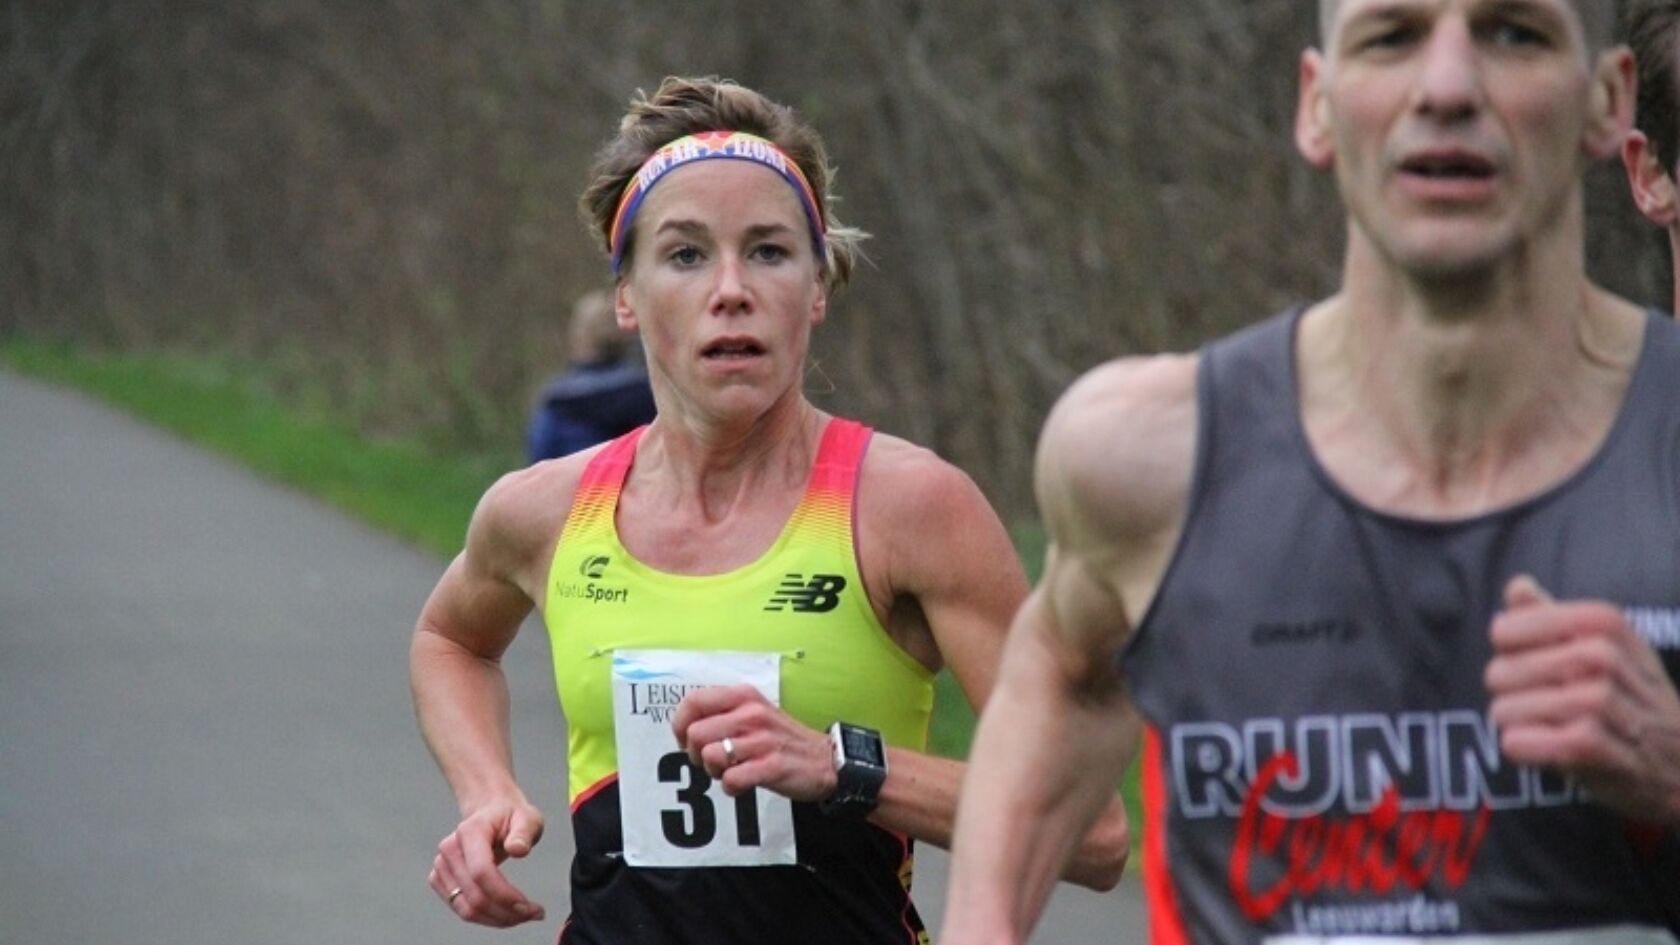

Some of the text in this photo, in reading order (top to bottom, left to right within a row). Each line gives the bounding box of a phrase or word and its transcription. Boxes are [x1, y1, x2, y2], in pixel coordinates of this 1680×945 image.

[555, 580, 629, 603] NatuSport
[763, 573, 847, 613] NB
[657, 751, 761, 849] 31
[1228, 750, 1492, 921] Center
